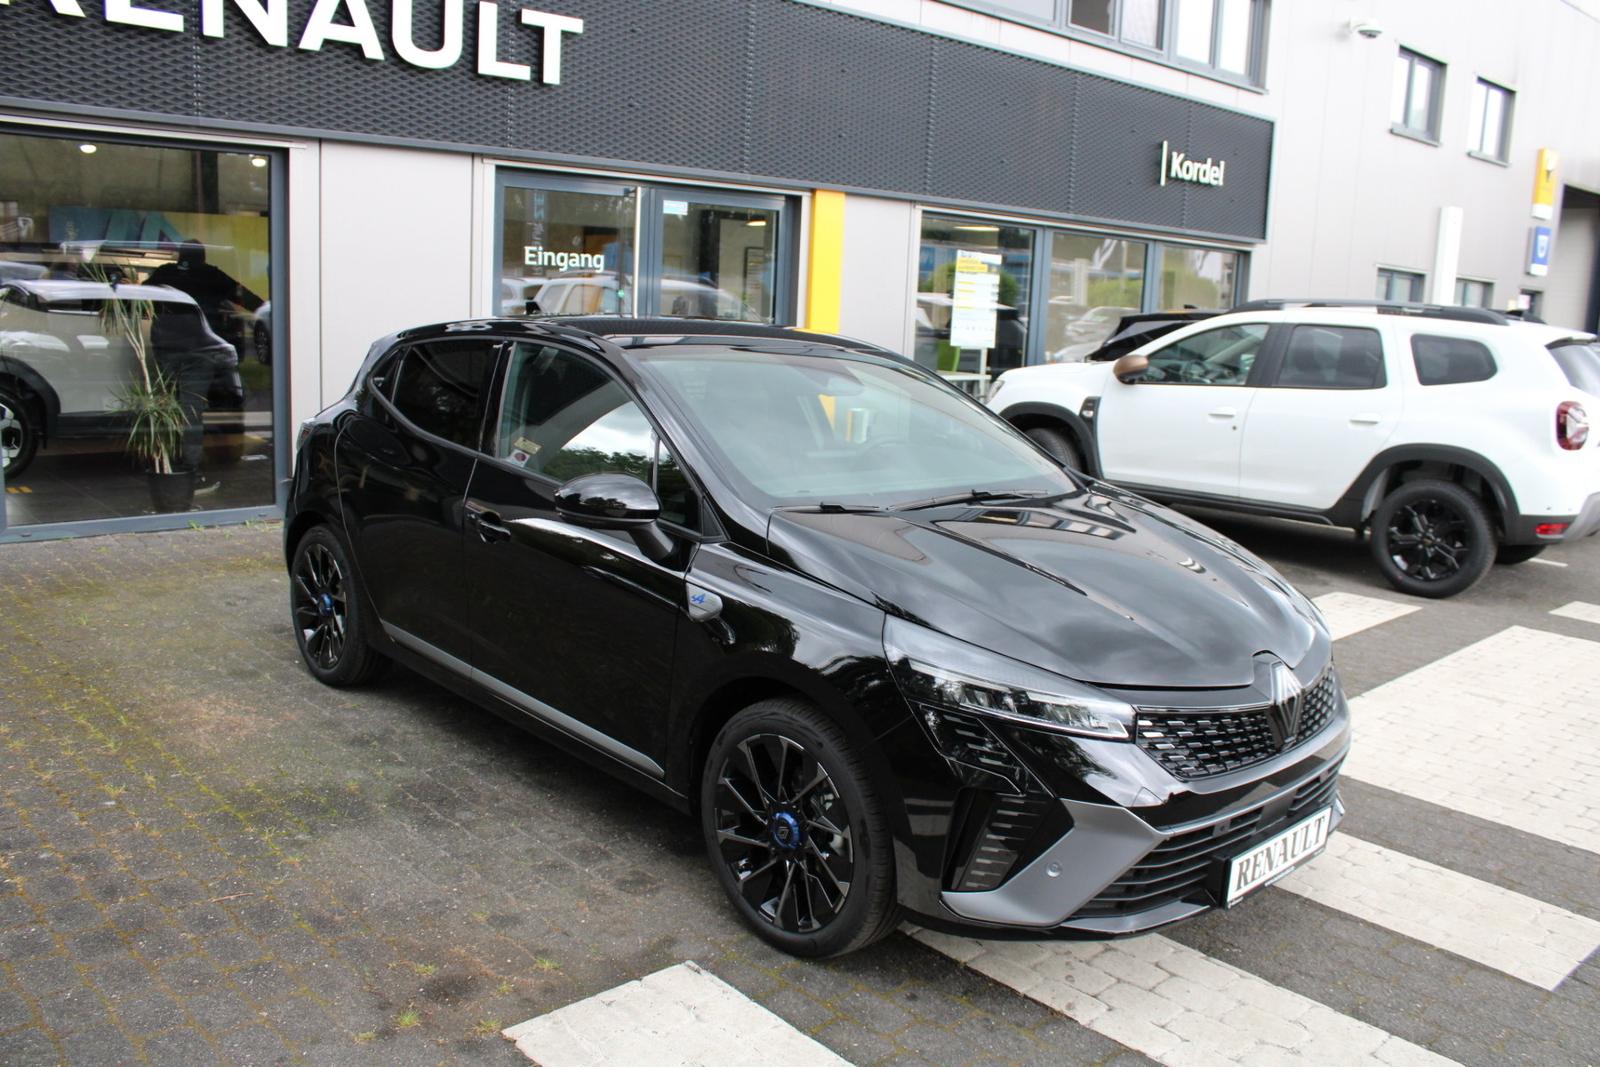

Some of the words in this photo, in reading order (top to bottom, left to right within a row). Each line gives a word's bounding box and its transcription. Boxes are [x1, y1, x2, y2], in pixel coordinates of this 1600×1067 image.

[0, 0, 583, 85] NAULT
[1170, 151, 1225, 186] Kordel
[524, 246, 604, 273] Eingang
[1236, 816, 1325, 892] RENAULT
